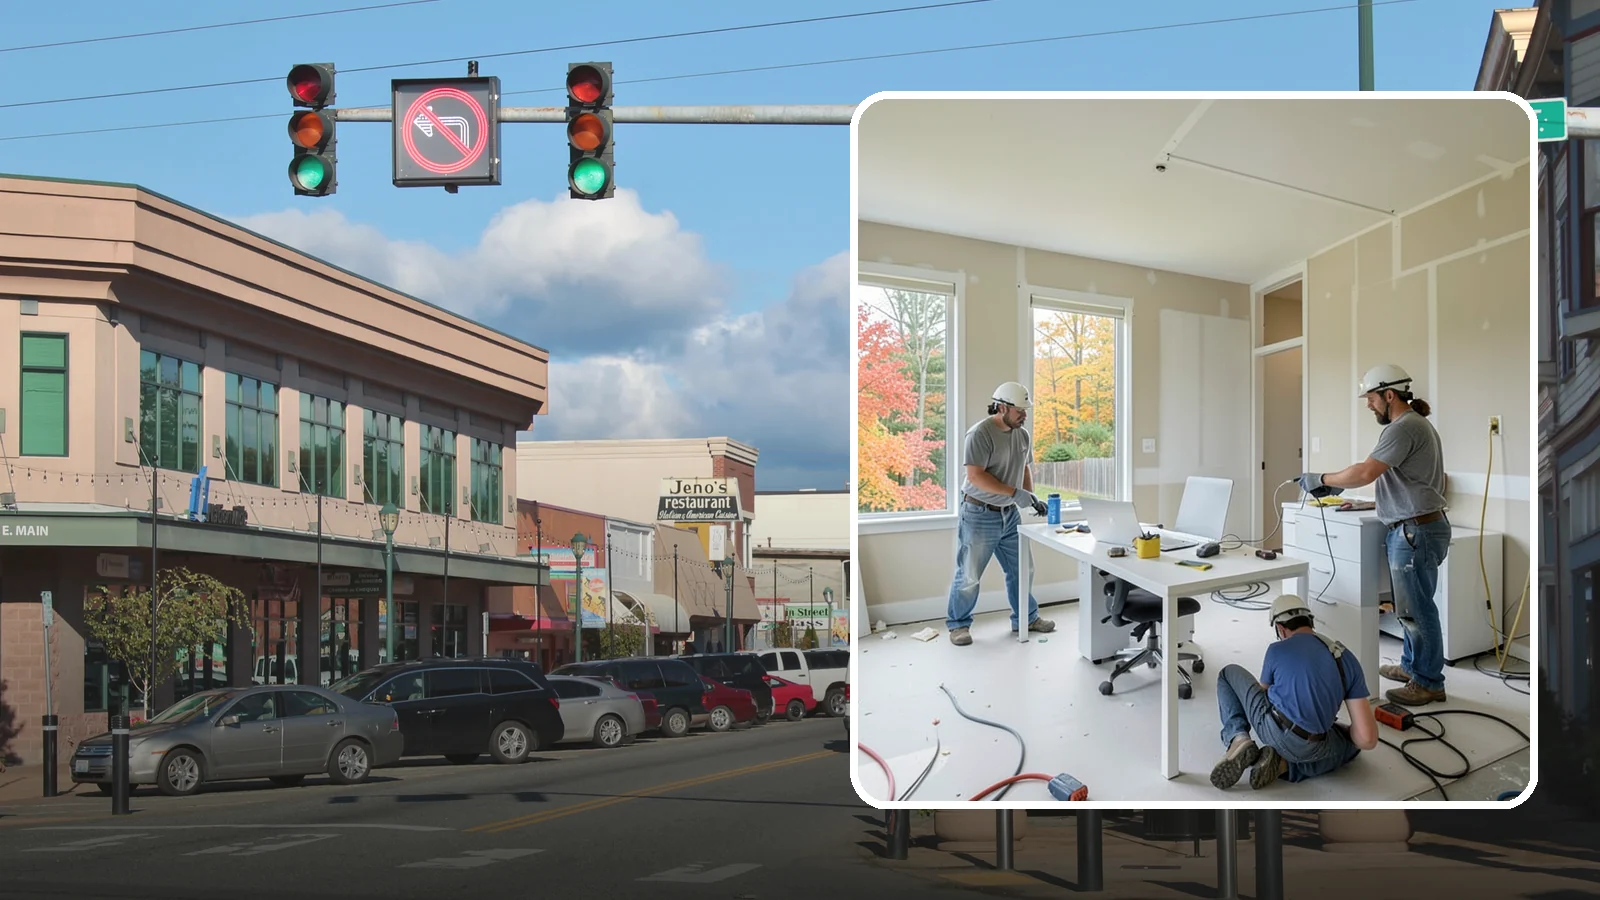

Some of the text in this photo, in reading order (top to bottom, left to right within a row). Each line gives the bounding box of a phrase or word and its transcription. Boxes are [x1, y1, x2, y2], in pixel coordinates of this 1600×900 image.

[670, 480, 727, 494] Jeno's
[665, 497, 731, 509] restaurant
[658, 510, 681, 519] Italian
[685, 510, 714, 519] American
[715, 510, 738, 519] Cuisine
[2, 525, 49, 536] E. MAIN
[797, 608, 829, 616] Street
